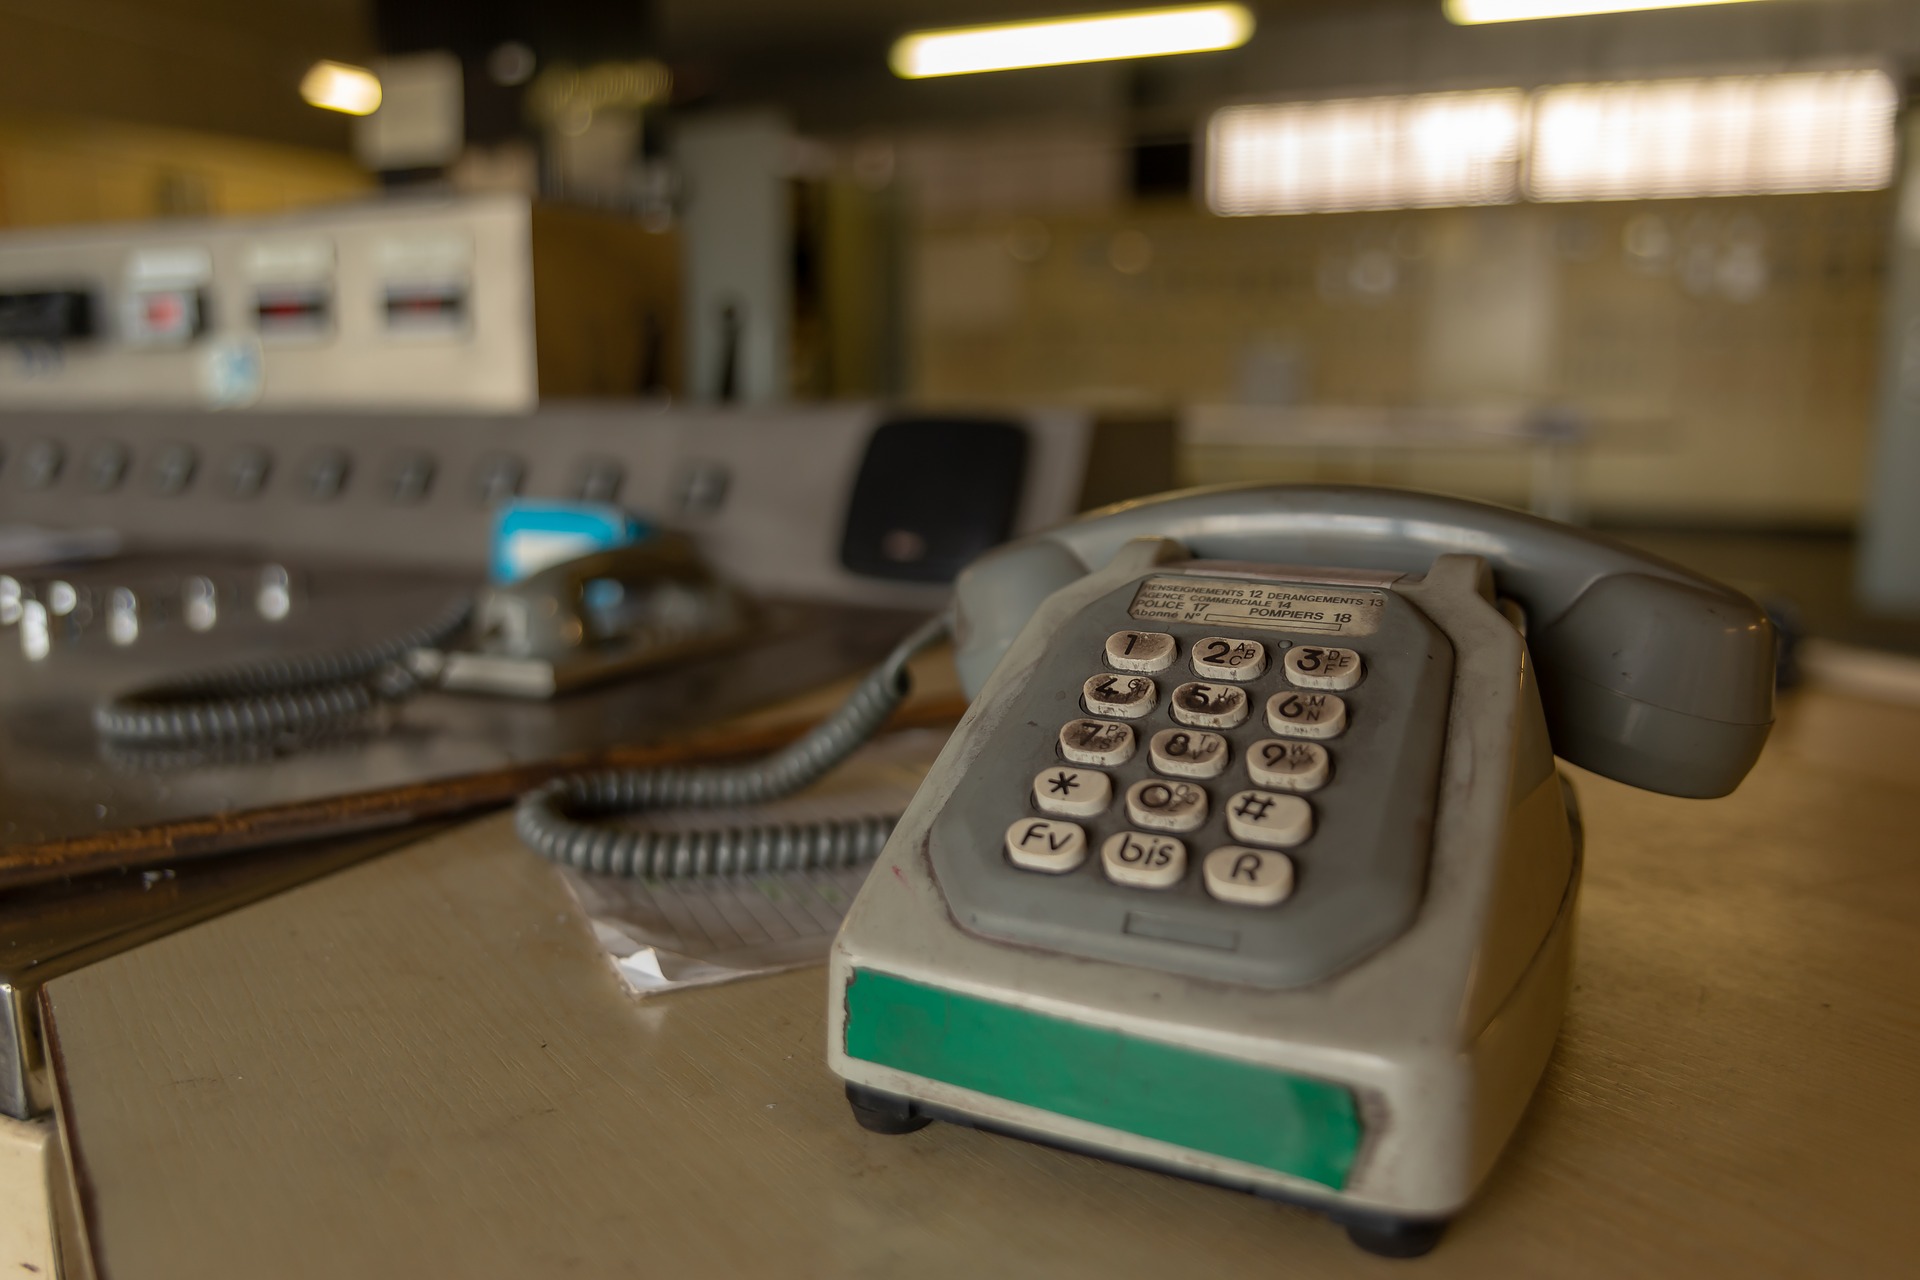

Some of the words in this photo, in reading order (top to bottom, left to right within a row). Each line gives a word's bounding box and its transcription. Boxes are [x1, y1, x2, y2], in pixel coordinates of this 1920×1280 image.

[1140, 592, 1185, 601] AGENCE
[1190, 595, 1272, 608] COMMERCIALE
[1277, 601, 1292, 609] 14
[1144, 584, 1245, 598] RENSEIGNEMENTS
[1249, 590, 1264, 599] 12
[1267, 592, 1364, 606] DERANGEMENTS
[1368, 599, 1385, 607] 13
[1133, 608, 1179, 619] Abonné
[1184, 611, 1202, 620] N°
[1135, 599, 1185, 610] POLICE
[1193, 603, 1211, 612] 17
[1249, 607, 1325, 620] POMPIERS
[1333, 613, 1352, 623] 18
[1123, 634, 1137, 655] 1
[1203, 641, 1231, 664] 2
[1297, 648, 1324, 672] 3
[1095, 677, 1120, 698] 4
[1184, 686, 1212, 709] 5
[1279, 695, 1303, 718] 6
[1079, 723, 1104, 746] 7
[1165, 733, 1190, 756] 8
[1262, 744, 1286, 767] 9
[1140, 784, 1172, 807] 0
[1235, 792, 1276, 821] #
[1120, 833, 1174, 867] bis
[1231, 852, 1263, 881] R
